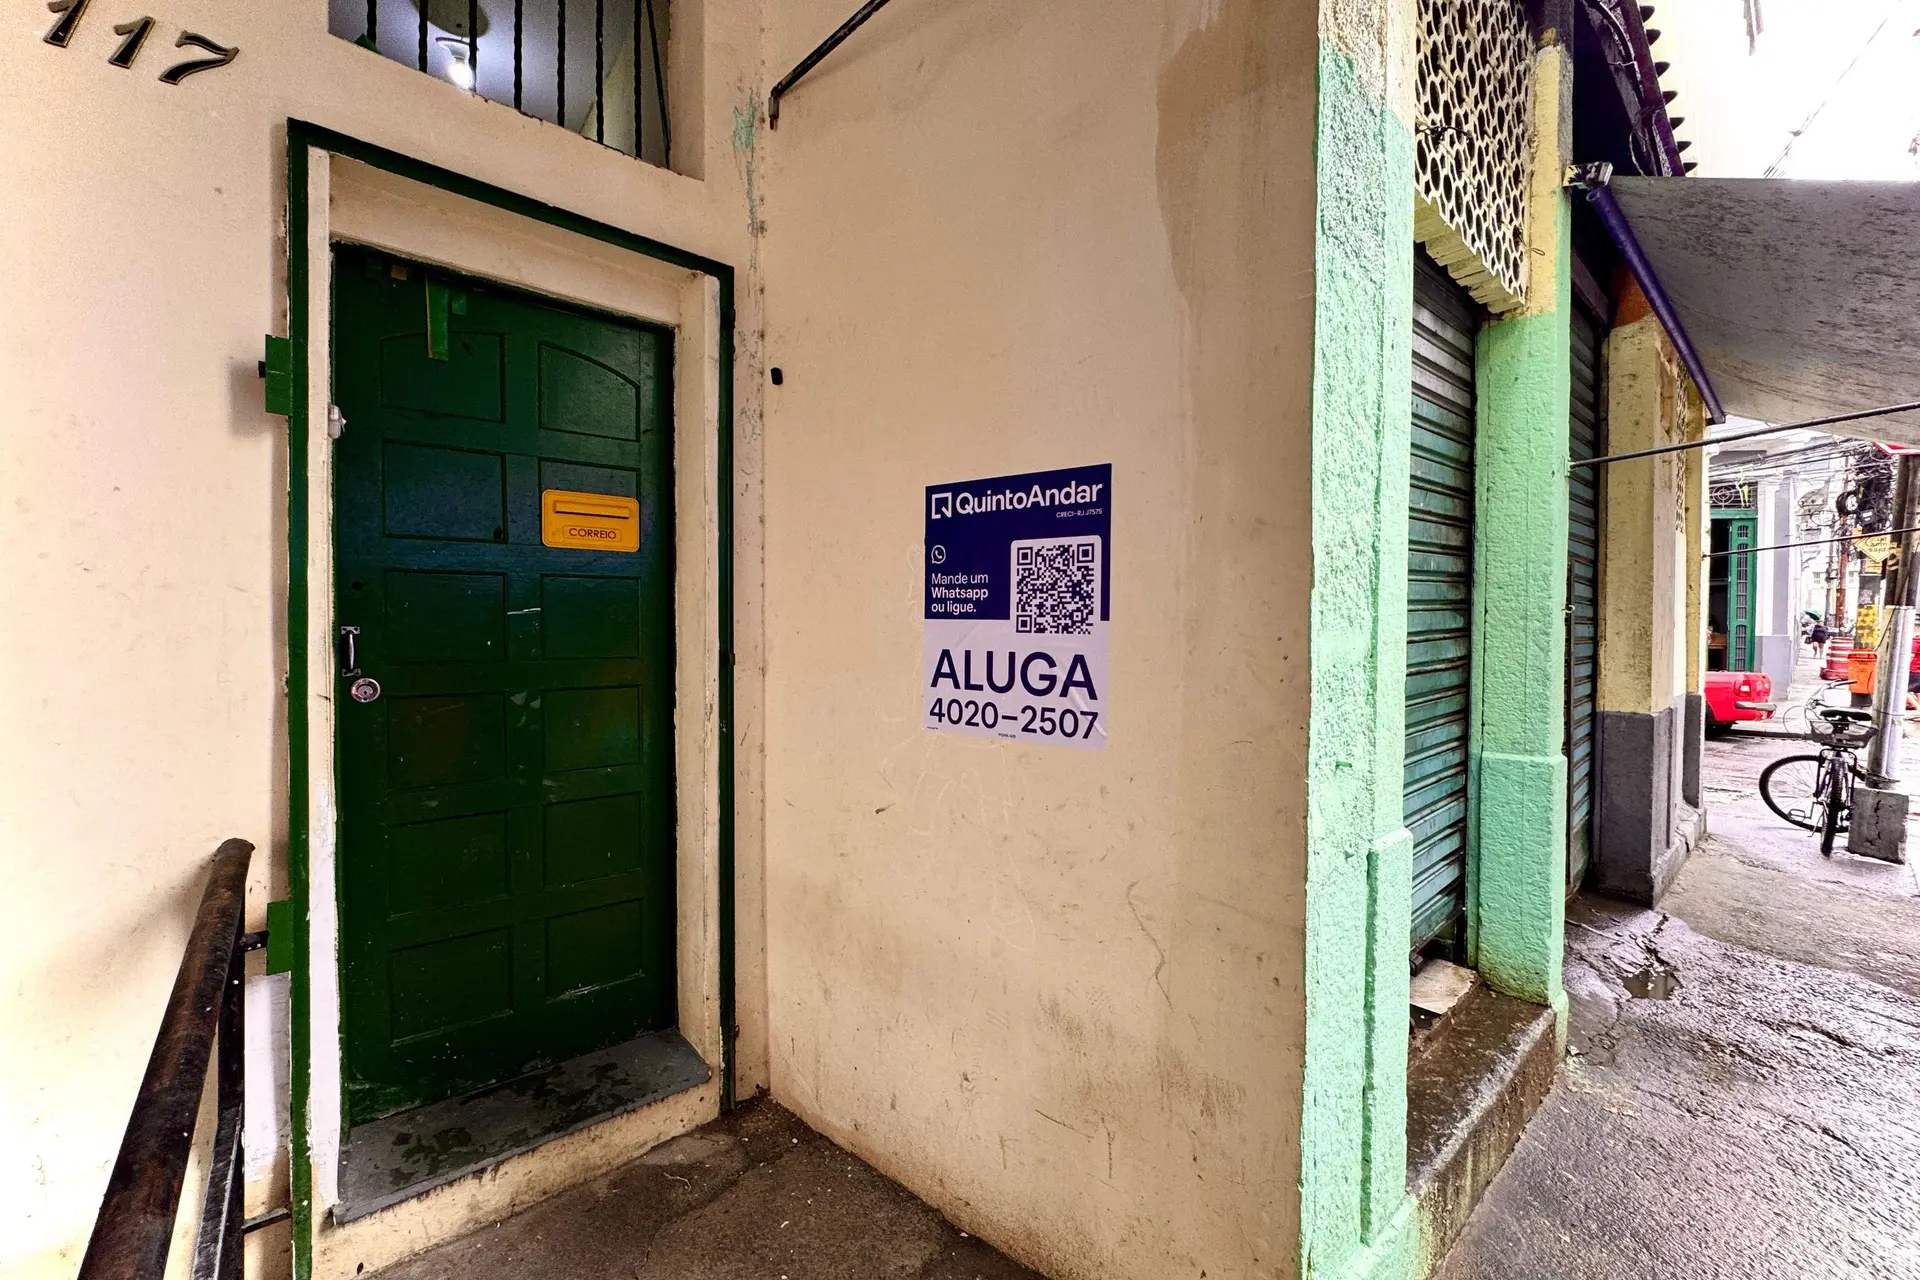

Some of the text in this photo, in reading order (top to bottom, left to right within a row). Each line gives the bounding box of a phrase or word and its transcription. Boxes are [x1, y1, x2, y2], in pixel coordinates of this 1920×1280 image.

[43, 0, 240, 85] 117
[955, 480, 1103, 515] QuintoAndar
[568, 527, 617, 539] CORREIO
[931, 572, 989, 585] Mande um
[931, 587, 989, 600] Whatsapp
[931, 600, 977, 615] ou ligue.
[930, 649, 1098, 700] ALUGA
[929, 698, 1099, 740] 4020-2507
